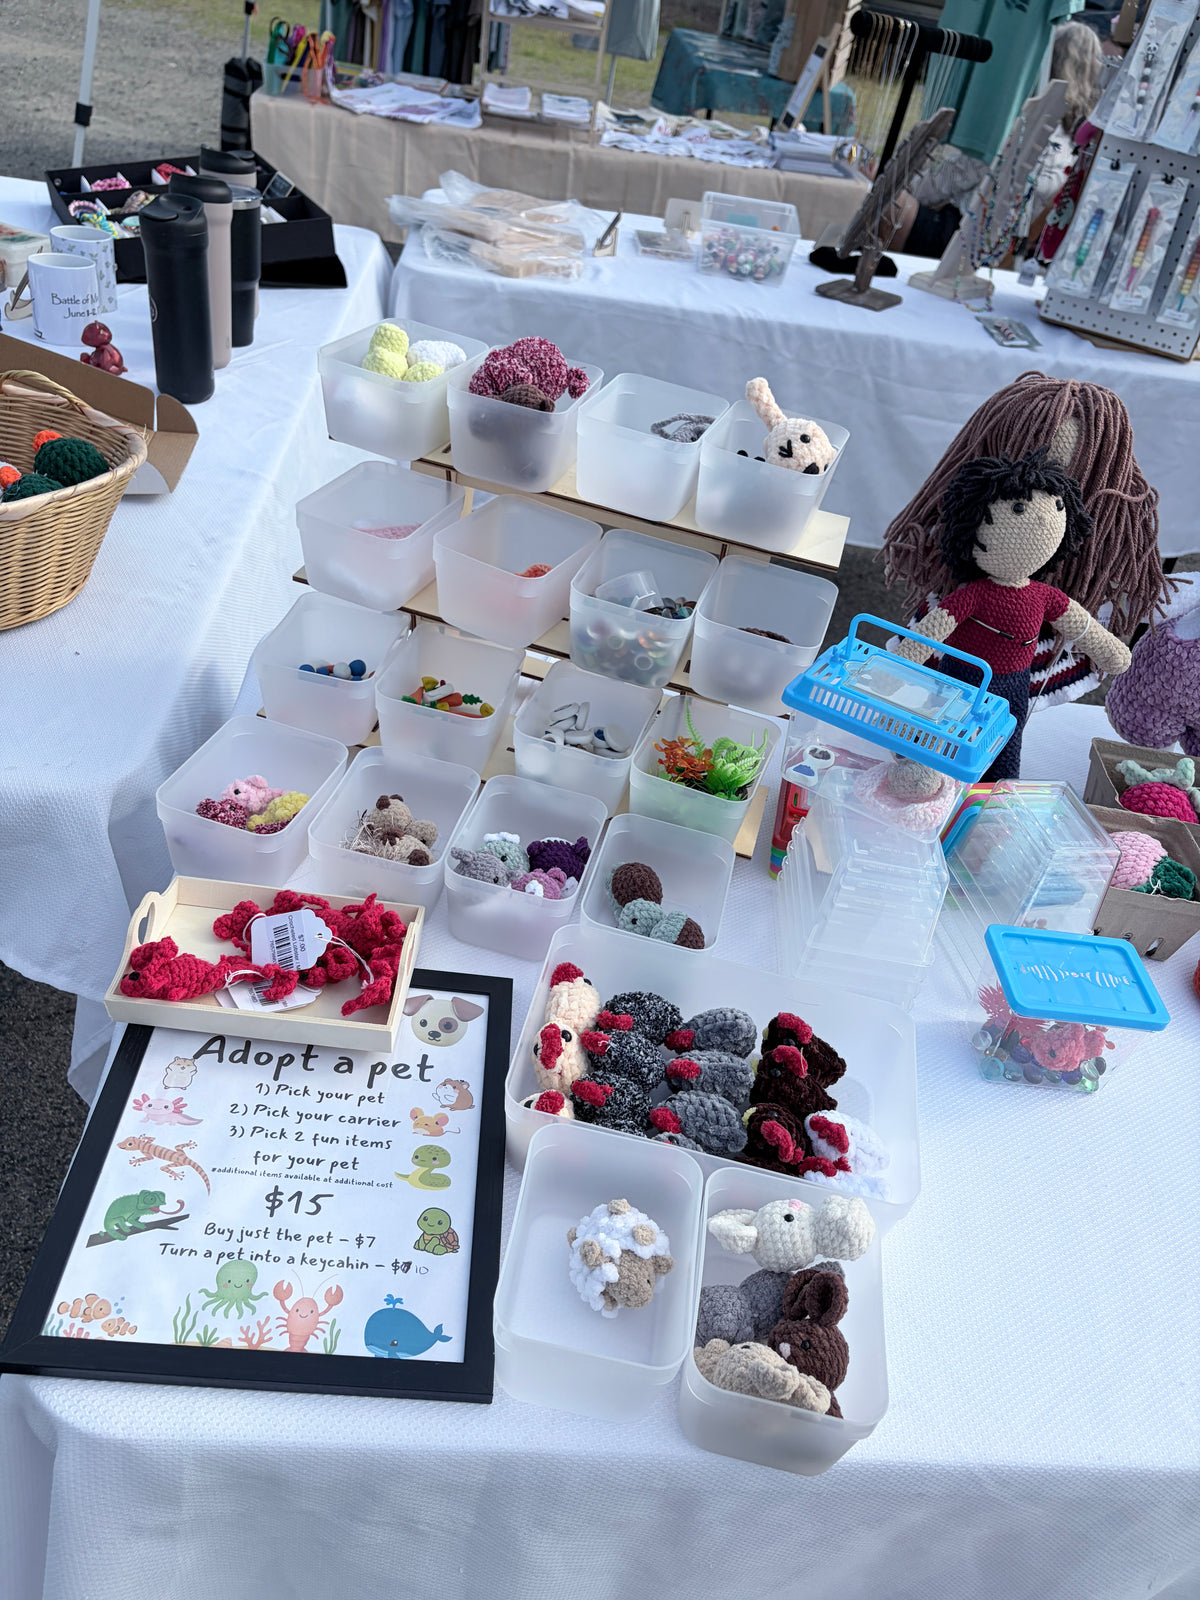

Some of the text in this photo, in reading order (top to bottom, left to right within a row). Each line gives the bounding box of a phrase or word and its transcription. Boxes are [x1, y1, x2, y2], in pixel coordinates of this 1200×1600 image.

[51, 293, 80, 305] Battle
[82, 294, 90, 305] of
[63, 307, 86, 319] June
[288, 915, 296, 941] Crocheted
[298, 934, 306, 952] $7.00
[193, 1035, 434, 1089] Adopt a pet
[255, 1083, 385, 1107] 1) Pick your pet
[229, 1103, 402, 1128] 2) Pick your carrier
[229, 1125, 393, 1149] 3) Pick 2 fun items
[253, 1150, 360, 1174] for your pet
[259, 1170, 283, 1179] items
[284, 1173, 321, 1182] available
[334, 1177, 374, 1188] additional
[376, 1181, 394, 1189] cost
[265, 1185, 334, 1218] $15
[204, 1222, 234, 1242] Buy
[236, 1226, 270, 1243] just
[276, 1227, 302, 1242] the
[306, 1232, 334, 1248] pet
[355, 1233, 376, 1249] $7
[159, 1243, 198, 1258] Turn
[203, 1249, 213, 1259] a
[215, 1248, 244, 1265] pet
[249, 1250, 281, 1264] into
[286, 1255, 295, 1265] a
[300, 1252, 369, 1272] keycahin
[415, 1264, 429, 1275] 10
